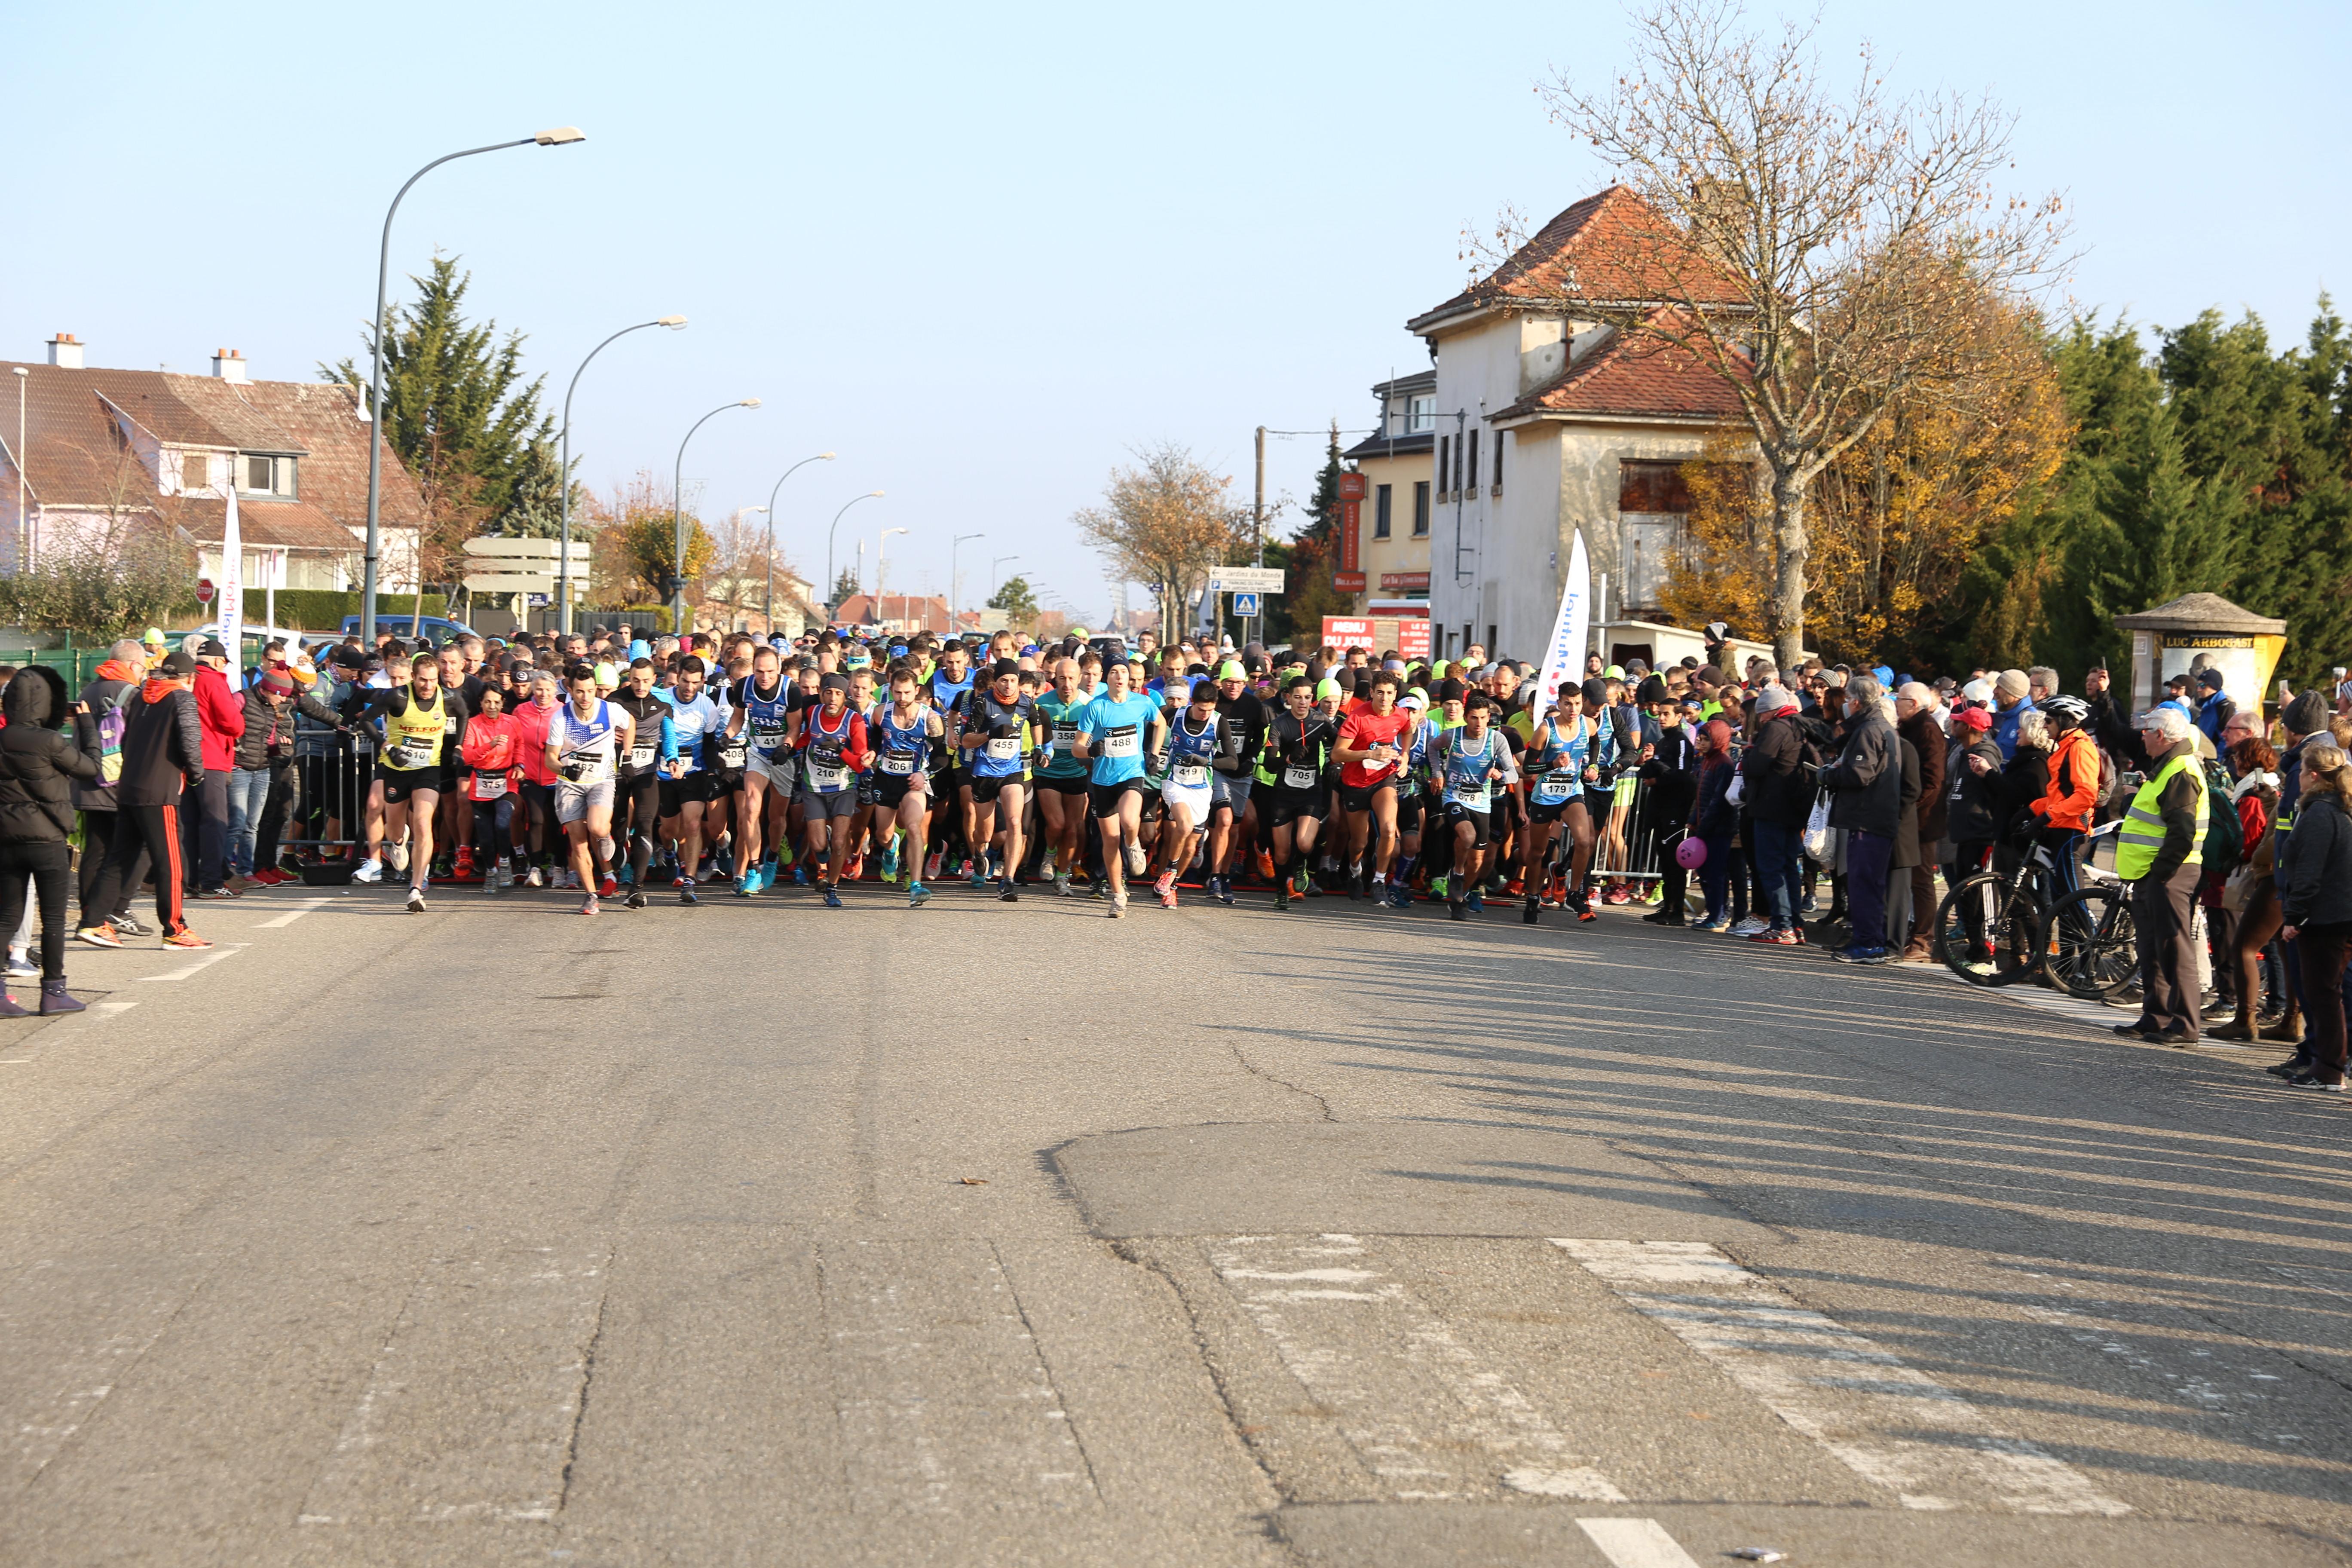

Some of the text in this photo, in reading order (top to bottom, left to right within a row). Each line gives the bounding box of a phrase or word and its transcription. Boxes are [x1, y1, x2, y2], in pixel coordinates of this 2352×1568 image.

[197, 586, 212, 594] STOP
[1332, 621, 1366, 633] MENU
[1323, 635, 1373, 648] DU JOUR
[2166, 637, 2188, 647] LUC
[2191, 637, 2254, 648] ARBOGAST
[1112, 738, 1131, 747] 488
[407, 749, 426, 760] 610
[725, 750, 743, 758] 408
[888, 761, 906, 771] 206
[817, 768, 834, 778] 210
[1292, 770, 1310, 780] 705
[481, 780, 501, 789] 375
[1548, 785, 1567, 793] 179
[1458, 793, 1476, 802] 678
